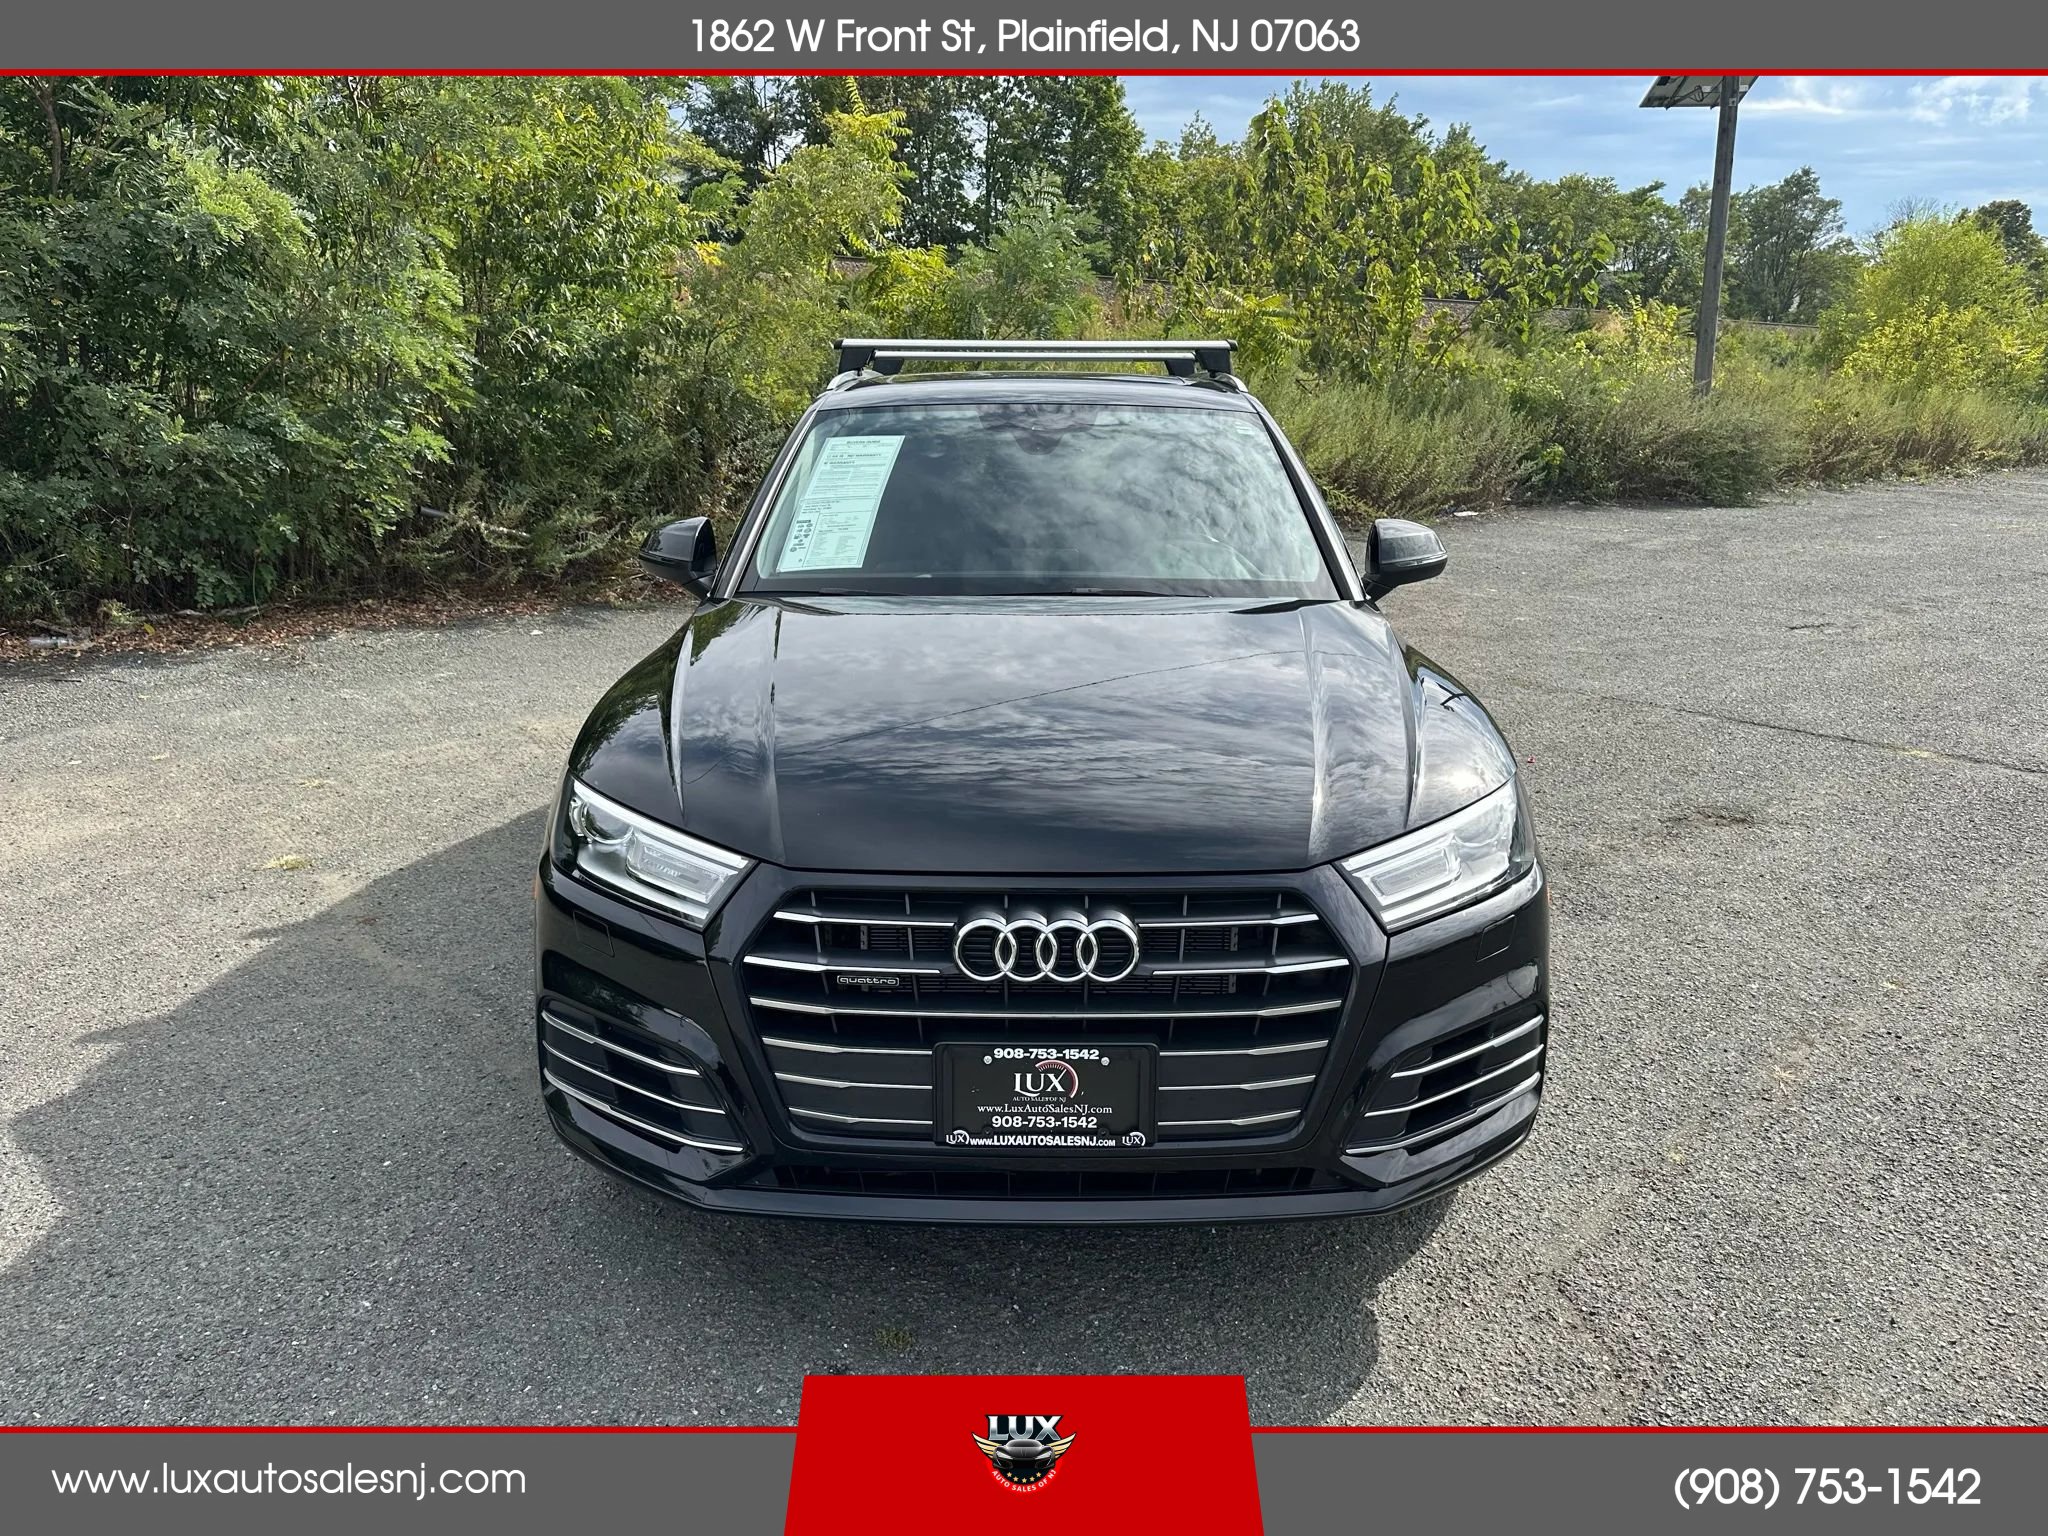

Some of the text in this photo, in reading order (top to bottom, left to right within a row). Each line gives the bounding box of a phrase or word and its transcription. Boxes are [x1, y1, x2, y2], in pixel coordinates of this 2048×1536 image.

[993, 1048, 1100, 1061] 908-753-1542
[1013, 1071, 1067, 1097] LUX
[977, 1103, 1113, 1116] www.LuxAutoSalesNJ.com
[991, 1115, 1098, 1129] 908-753-1542
[945, 1133, 966, 1145] LUX
[1122, 1135, 1142, 1146] LUX
